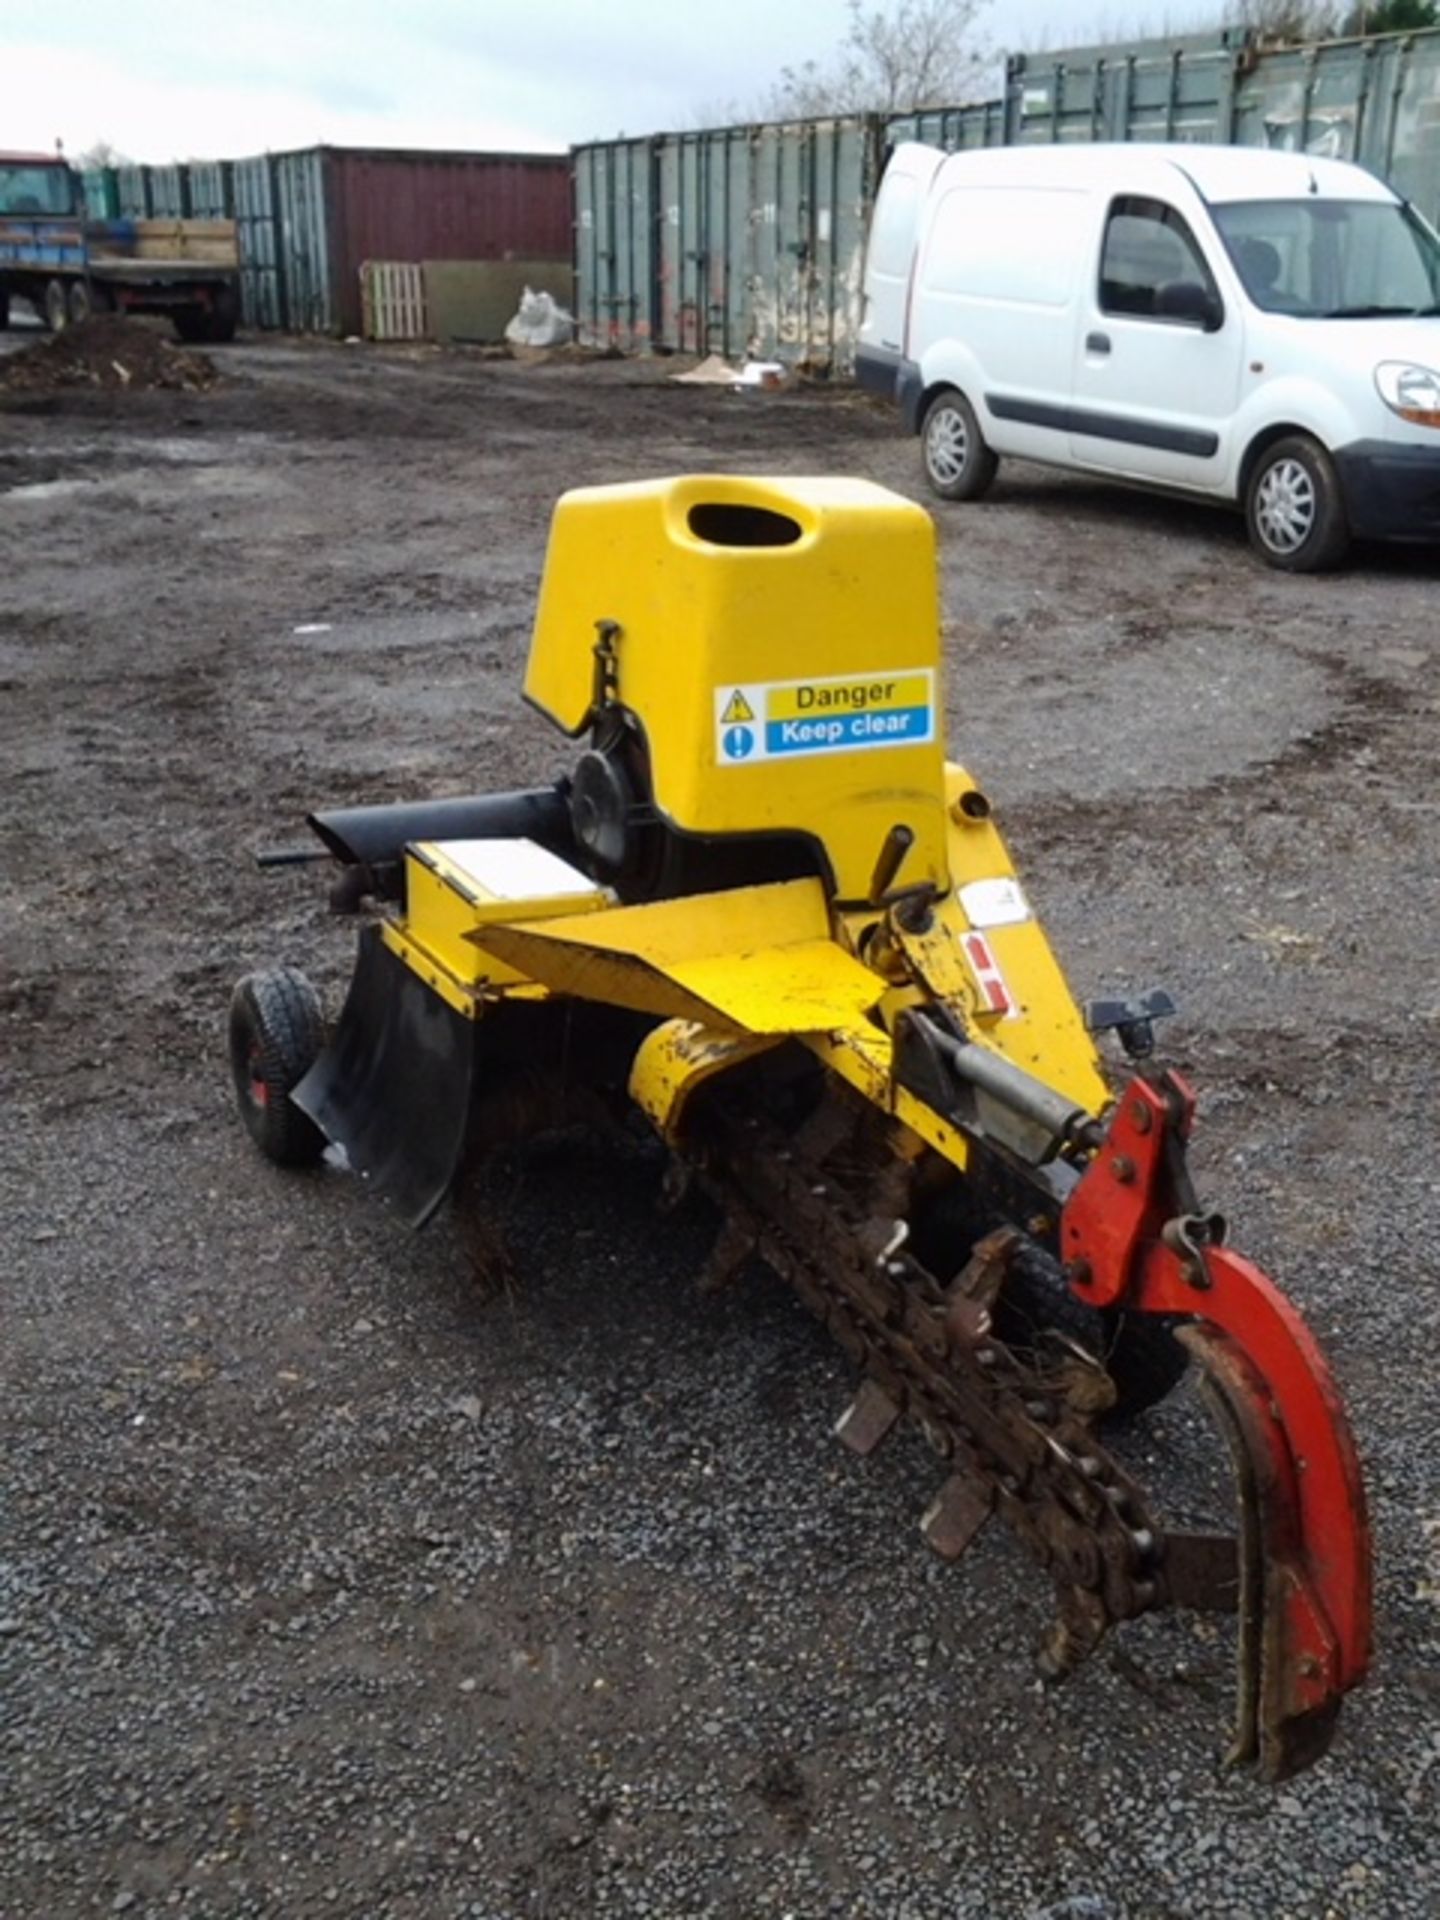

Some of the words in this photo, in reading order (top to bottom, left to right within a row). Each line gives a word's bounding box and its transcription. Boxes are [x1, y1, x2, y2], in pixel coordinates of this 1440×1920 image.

[796, 682, 896, 709] Danger
[781, 721, 843, 744] Keep
[851, 713, 911, 736] clear
